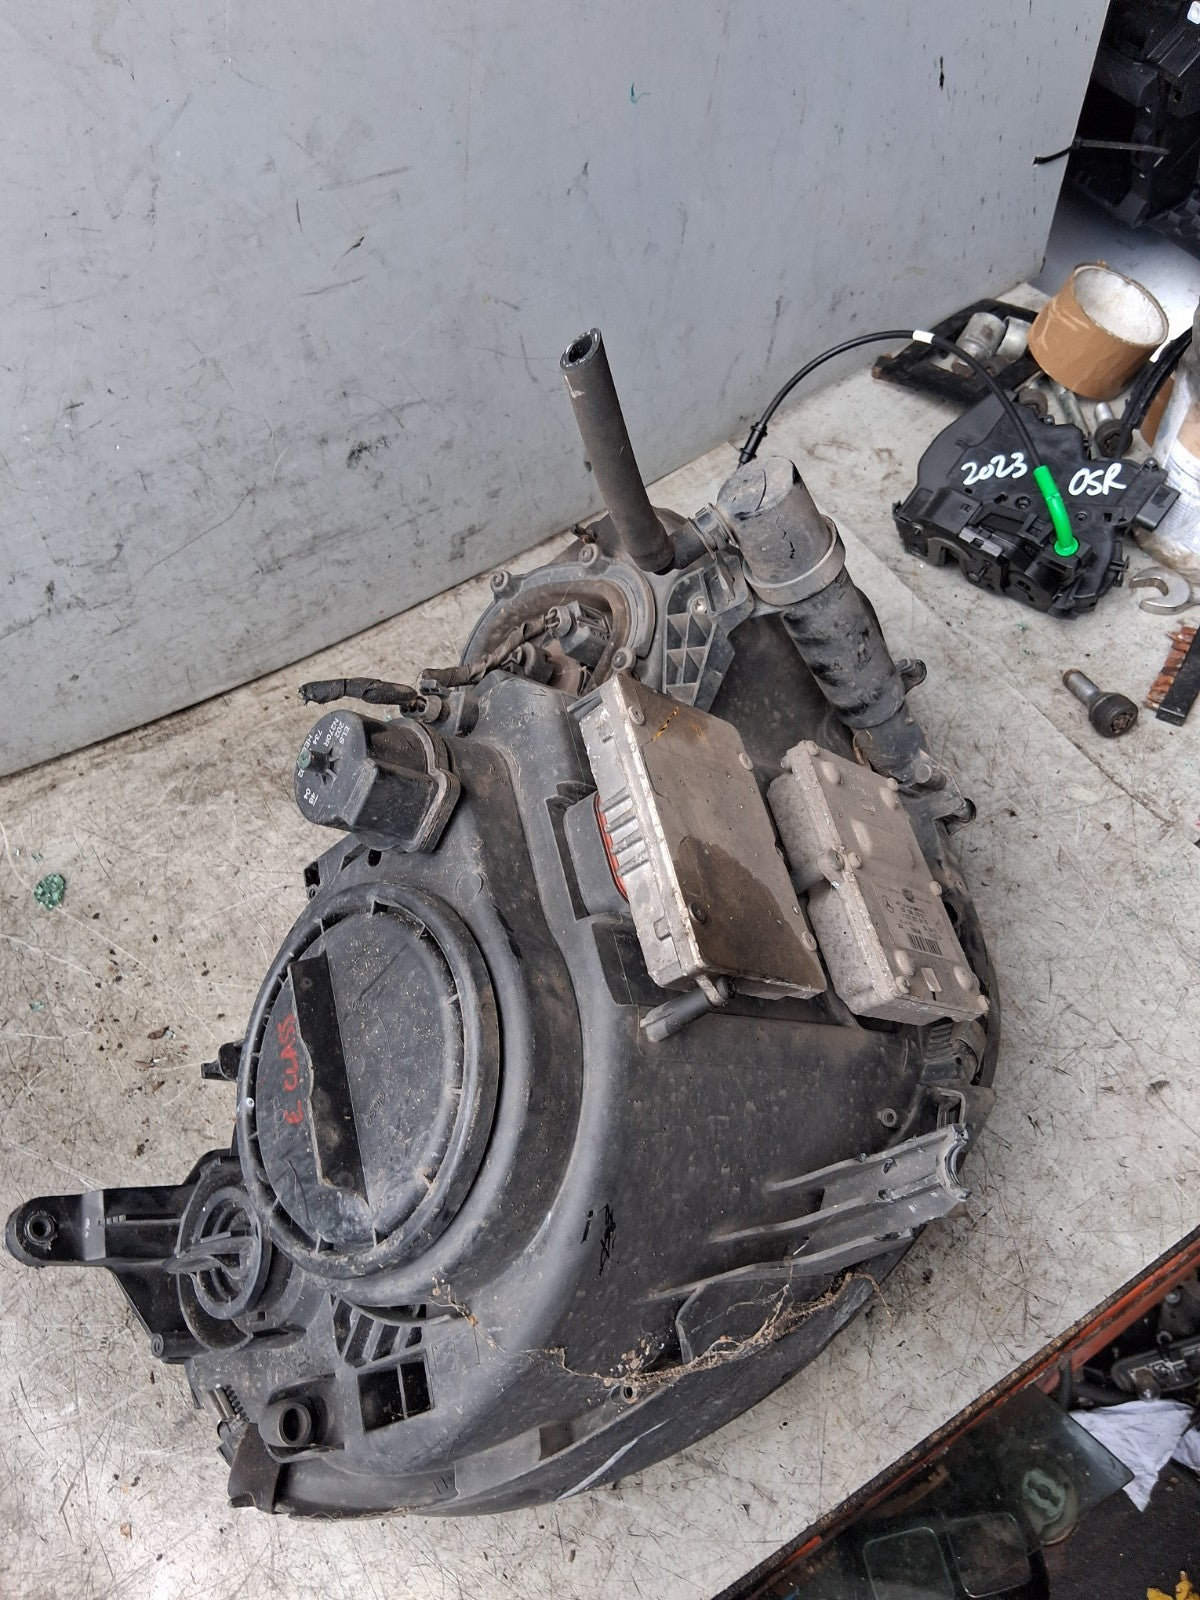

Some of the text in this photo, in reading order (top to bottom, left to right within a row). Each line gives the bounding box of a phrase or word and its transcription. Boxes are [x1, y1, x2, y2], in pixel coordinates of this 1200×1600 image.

[961, 452, 1028, 486] 2023
[1068, 462, 1127, 496] OSR
[276, 1013, 304, 1125] E CLASS
